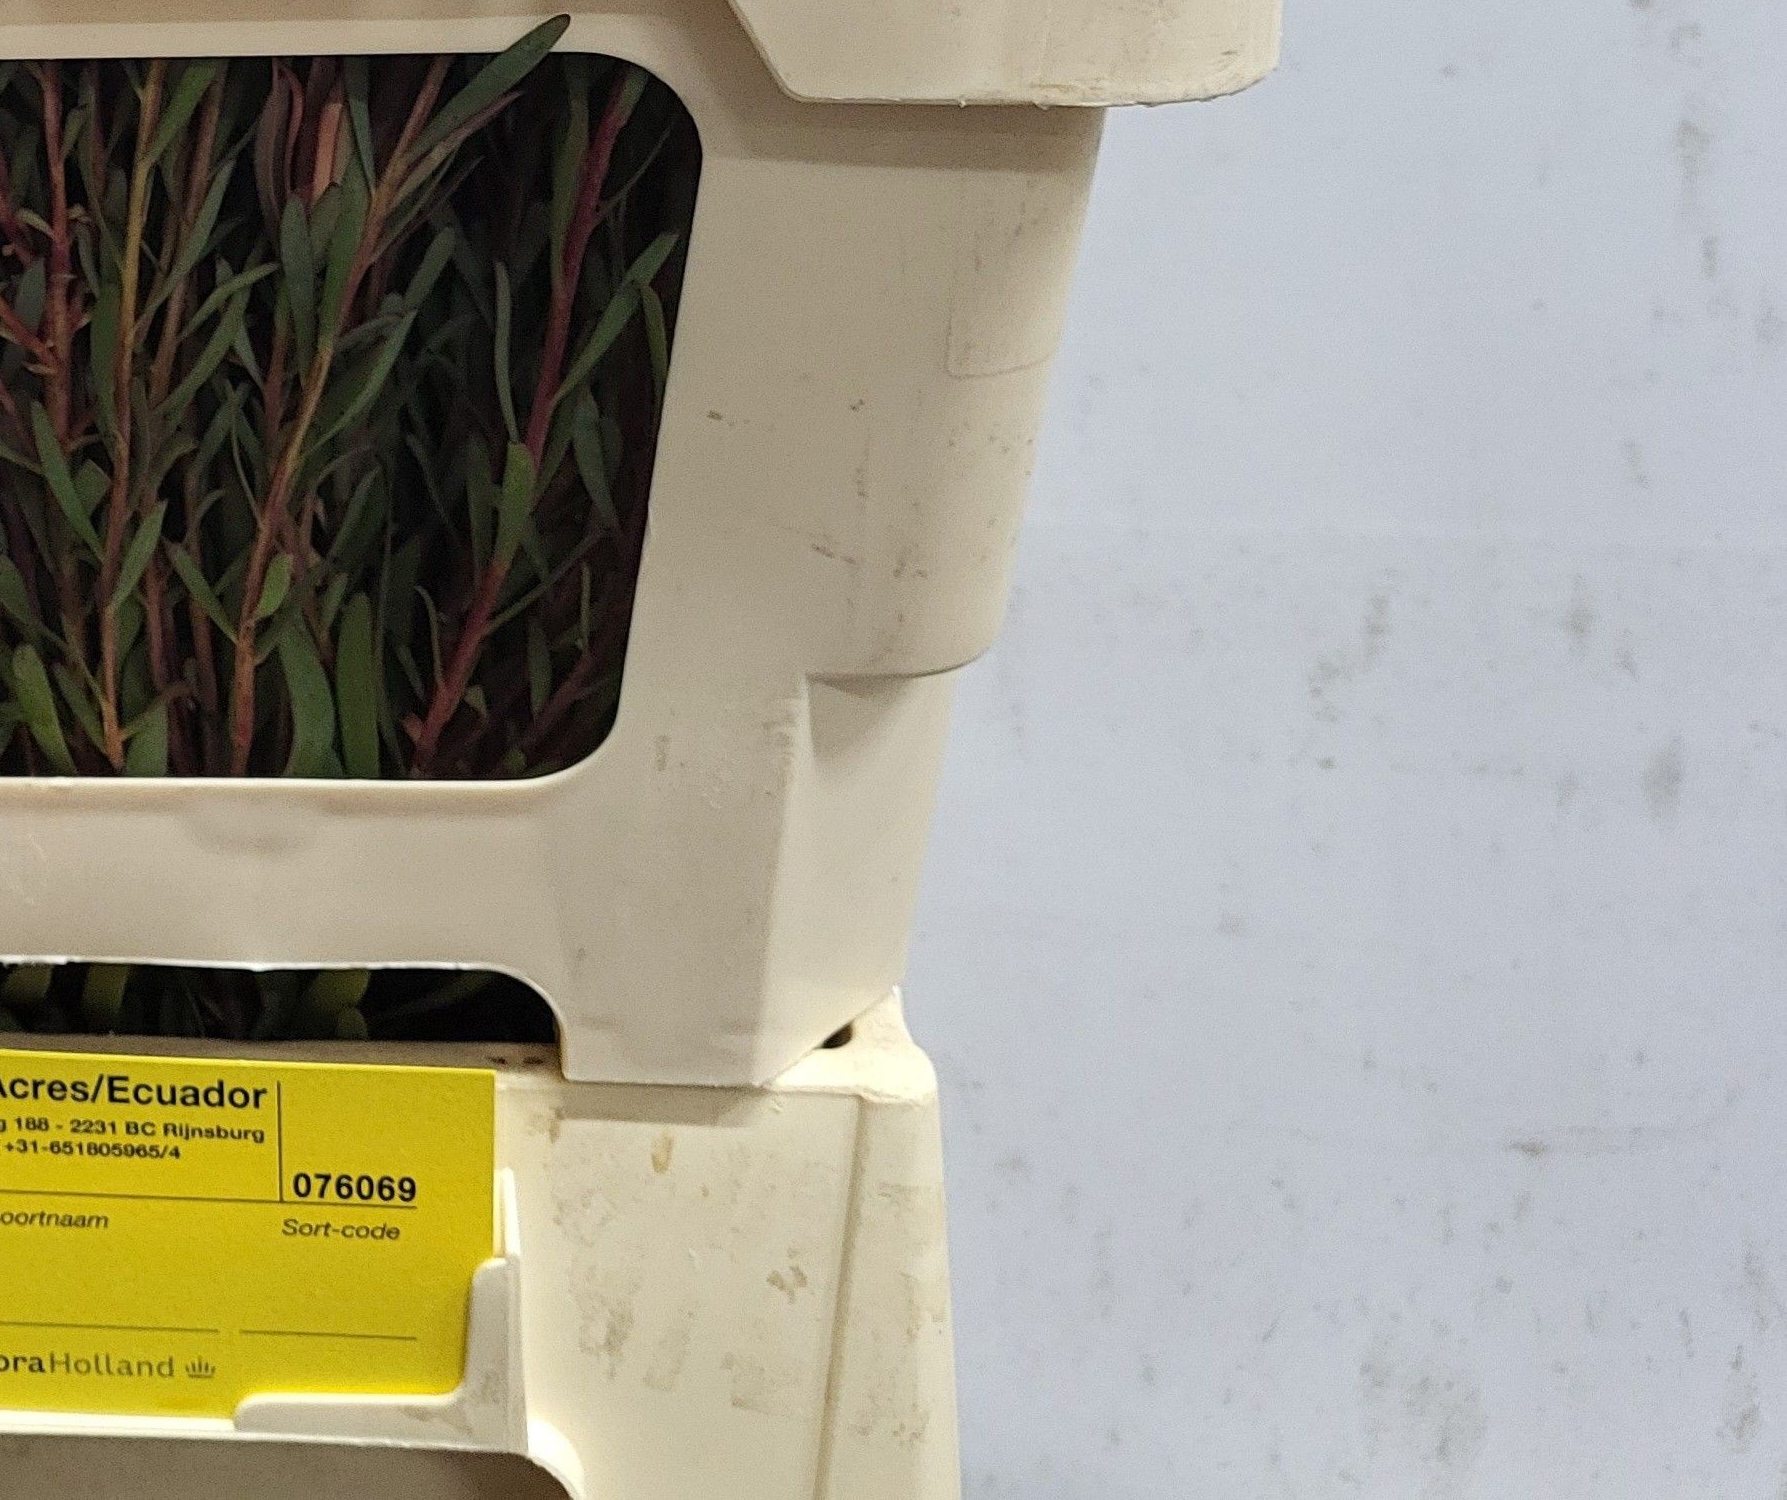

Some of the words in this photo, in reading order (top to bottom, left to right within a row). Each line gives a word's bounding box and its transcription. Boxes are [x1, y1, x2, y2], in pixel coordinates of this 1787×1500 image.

[15, 1117, 49, 1132] 188
[70, 1119, 117, 1135] 2231
[126, 1121, 156, 1136] BC
[163, 1122, 265, 1143] Rijnsburg
[293, 1172, 417, 1202] 076069
[282, 1218, 400, 1240] Sort-code
